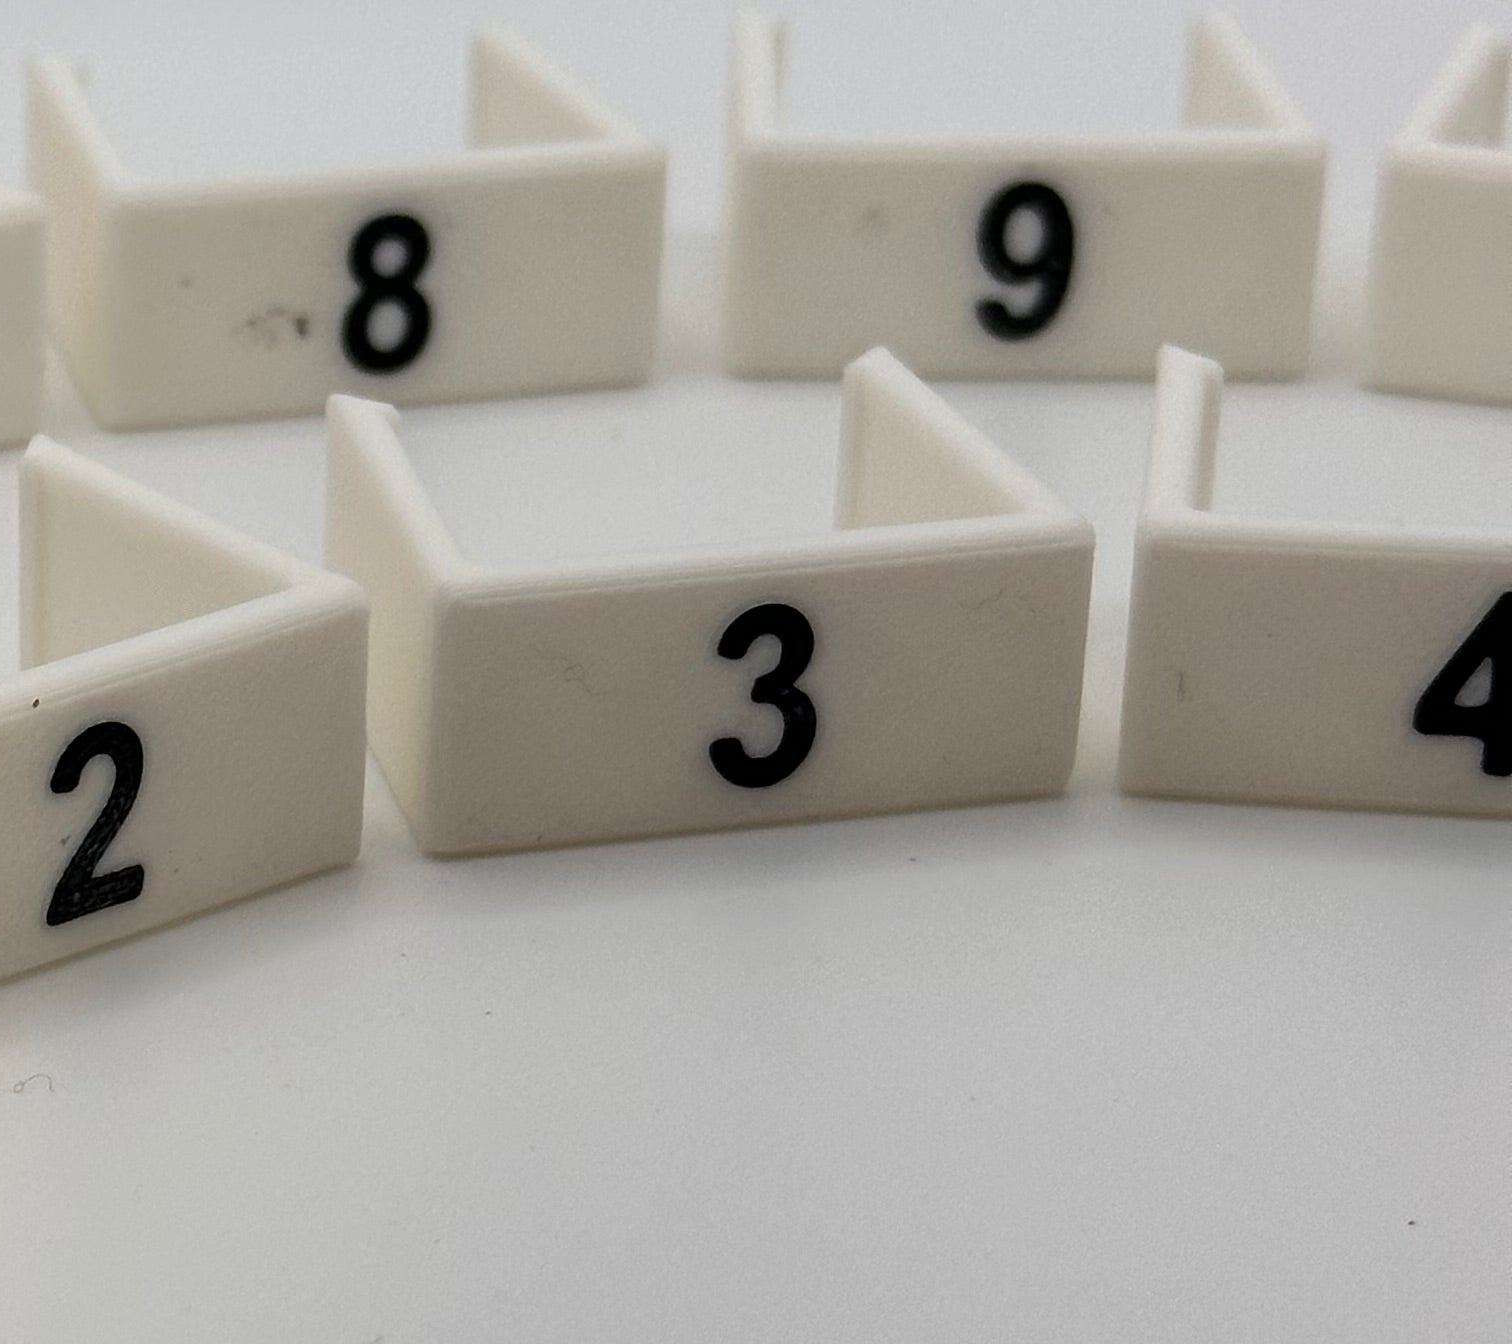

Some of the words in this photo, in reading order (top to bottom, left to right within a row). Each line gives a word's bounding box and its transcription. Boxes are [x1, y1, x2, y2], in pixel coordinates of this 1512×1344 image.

[338, 209, 435, 379] 8
[974, 177, 1080, 344] 9
[703, 601, 824, 799] 3
[1409, 588, 1512, 784] 4
[44, 719, 147, 930] 2
